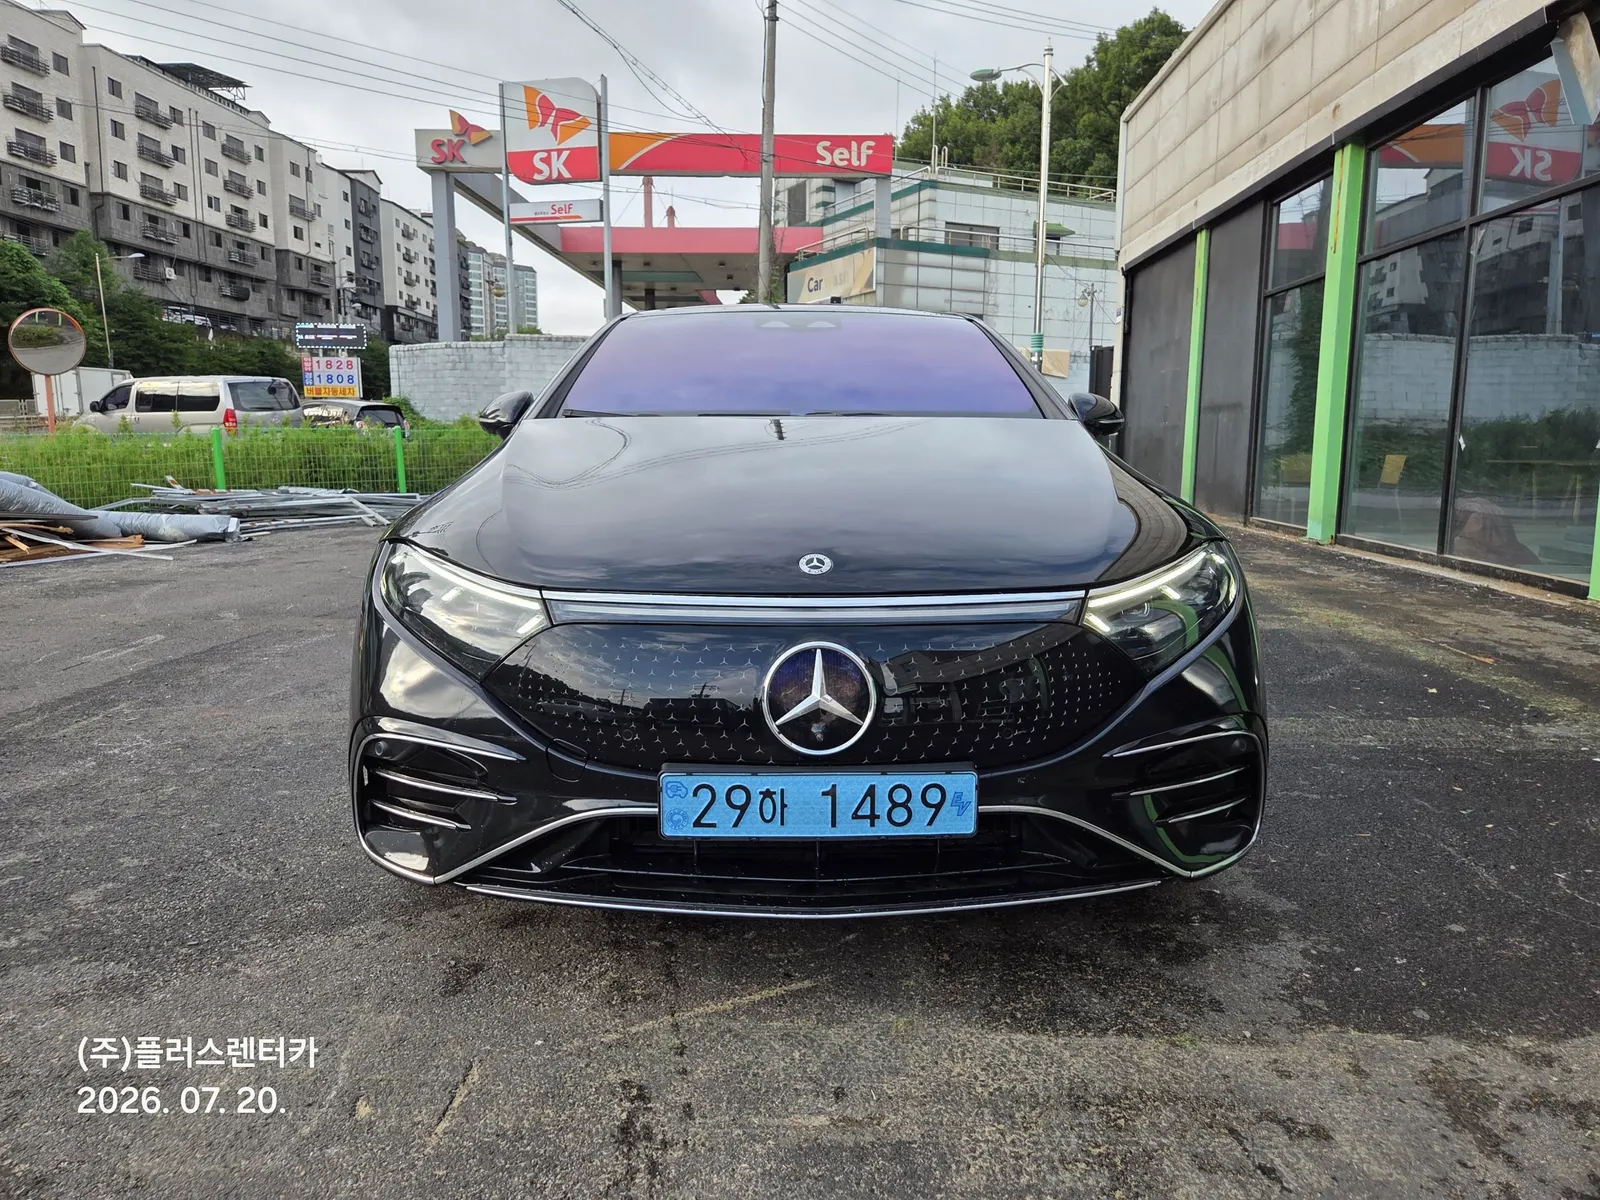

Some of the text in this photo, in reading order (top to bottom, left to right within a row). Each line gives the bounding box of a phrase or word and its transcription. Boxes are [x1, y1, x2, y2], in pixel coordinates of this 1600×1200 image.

[431, 138, 467, 164] SK
[816, 140, 876, 167] Self
[532, 150, 572, 181] SK
[551, 203, 573, 214] Self
[807, 277, 823, 293] Car
[316, 360, 353, 369] 1828
[317, 374, 354, 383] 1808
[692, 783, 787, 828] 29하
[821, 783, 946, 828] 1489
[951, 791, 971, 816] EV
